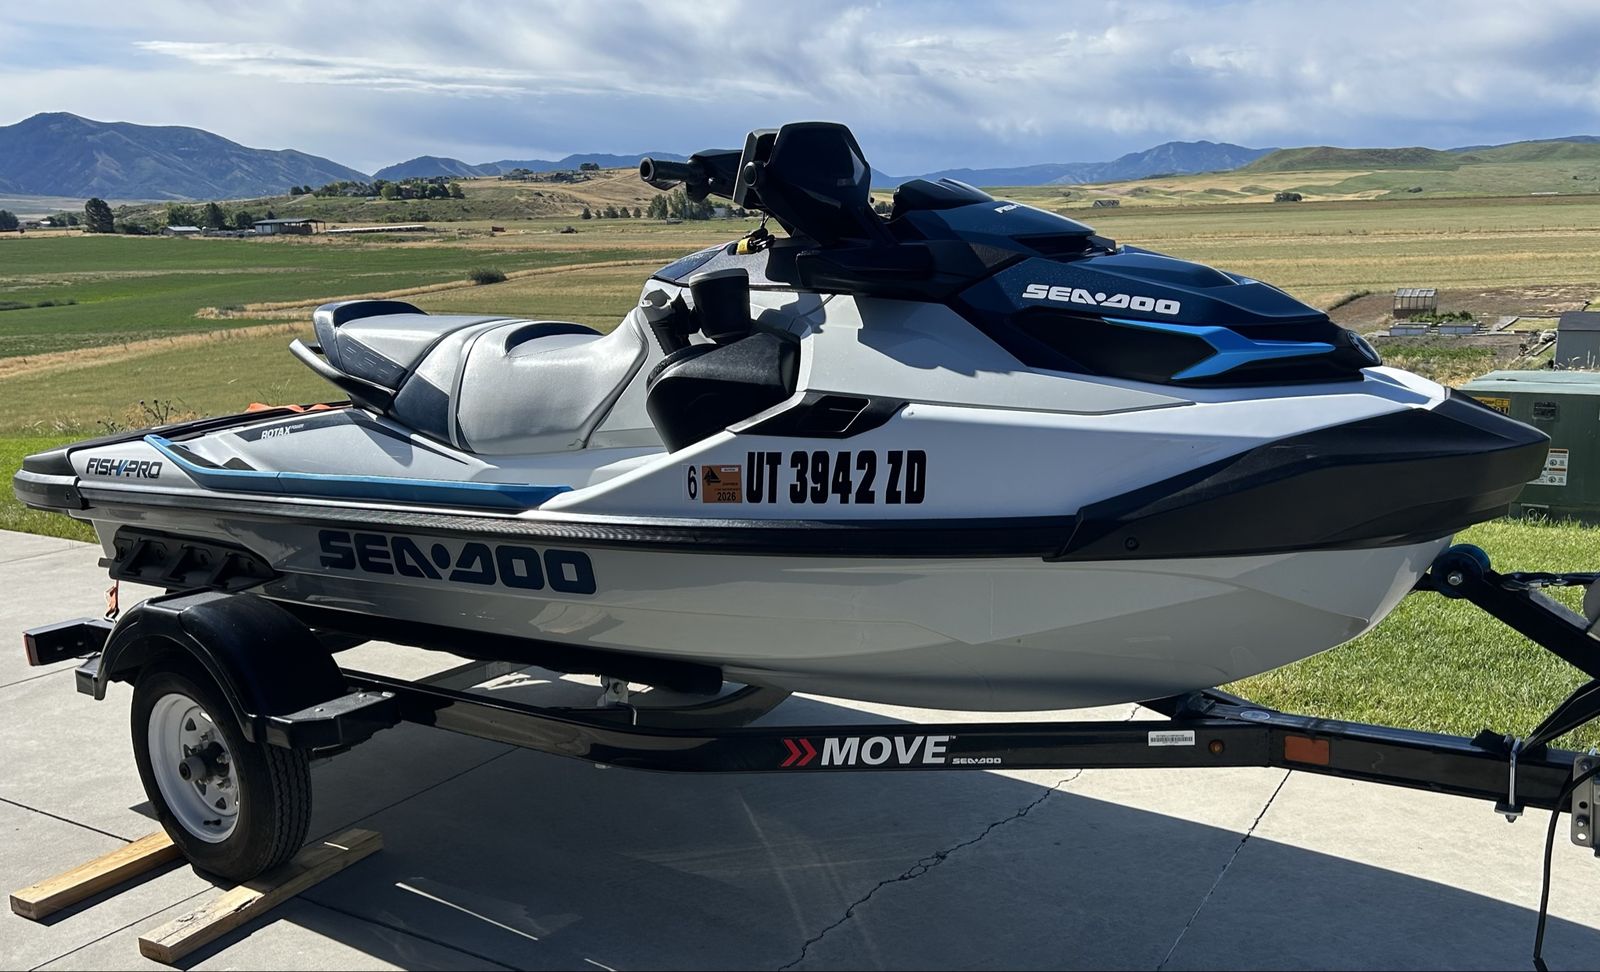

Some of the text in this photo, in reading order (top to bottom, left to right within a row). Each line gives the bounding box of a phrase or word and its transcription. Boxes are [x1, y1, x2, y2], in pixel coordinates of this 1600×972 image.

[261, 426, 291, 440] ROTAX
[687, 465, 698, 500] 6
[746, 450, 927, 504] UT 3942 ZD
[716, 491, 737, 502] 2026
[821, 735, 949, 766] MOVE
